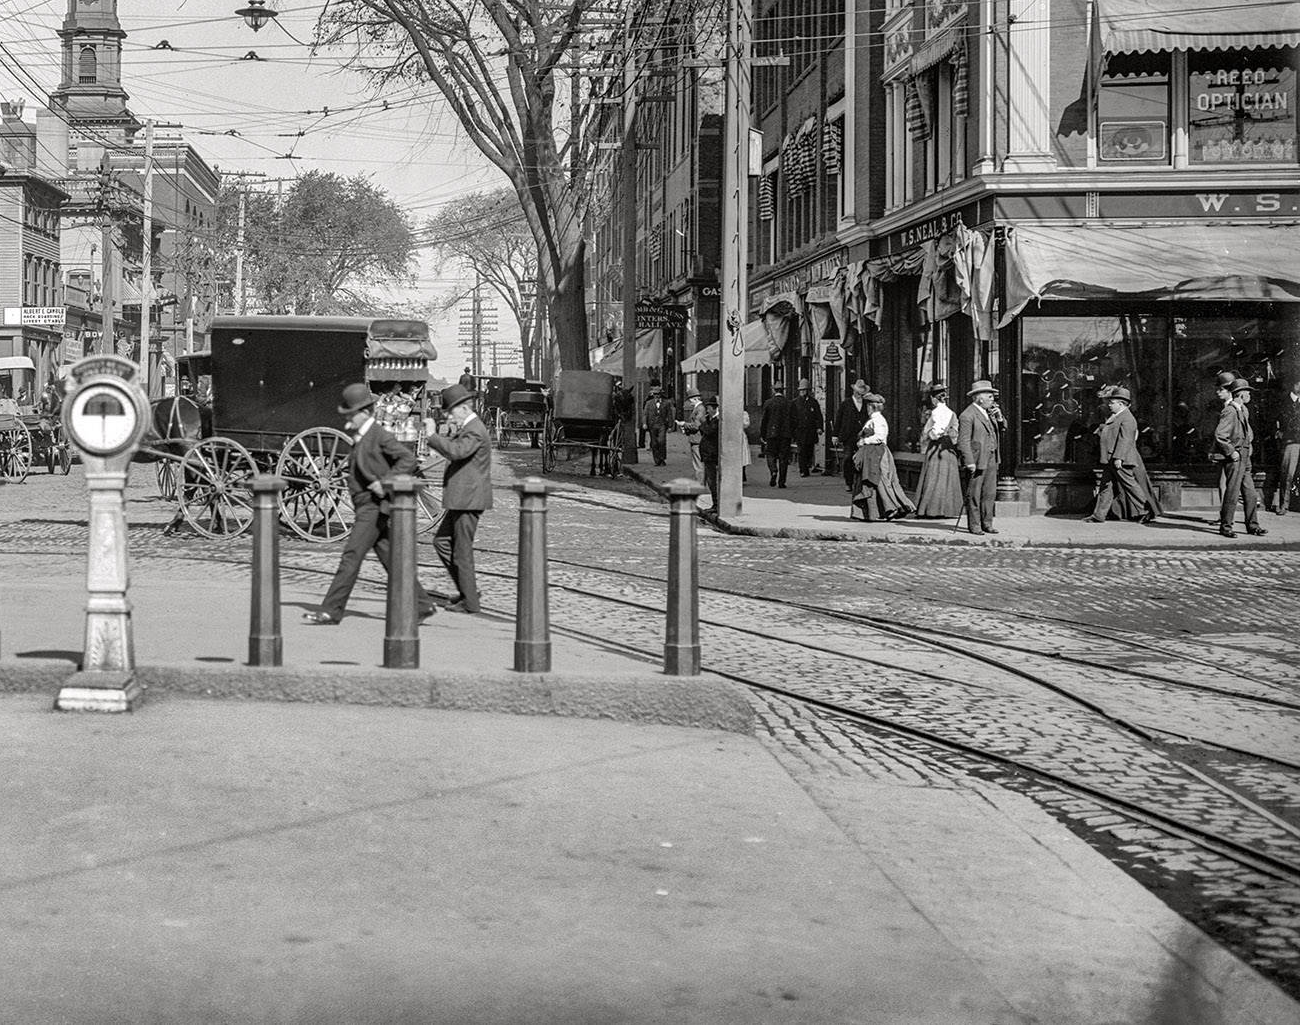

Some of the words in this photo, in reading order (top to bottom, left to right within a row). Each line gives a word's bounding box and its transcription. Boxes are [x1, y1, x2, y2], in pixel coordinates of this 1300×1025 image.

[1217, 69, 1266, 85] REED
[1197, 92, 1288, 111] OPTICIAN
[1195, 193, 1240, 212] W.
[1256, 193, 1298, 212] S.
